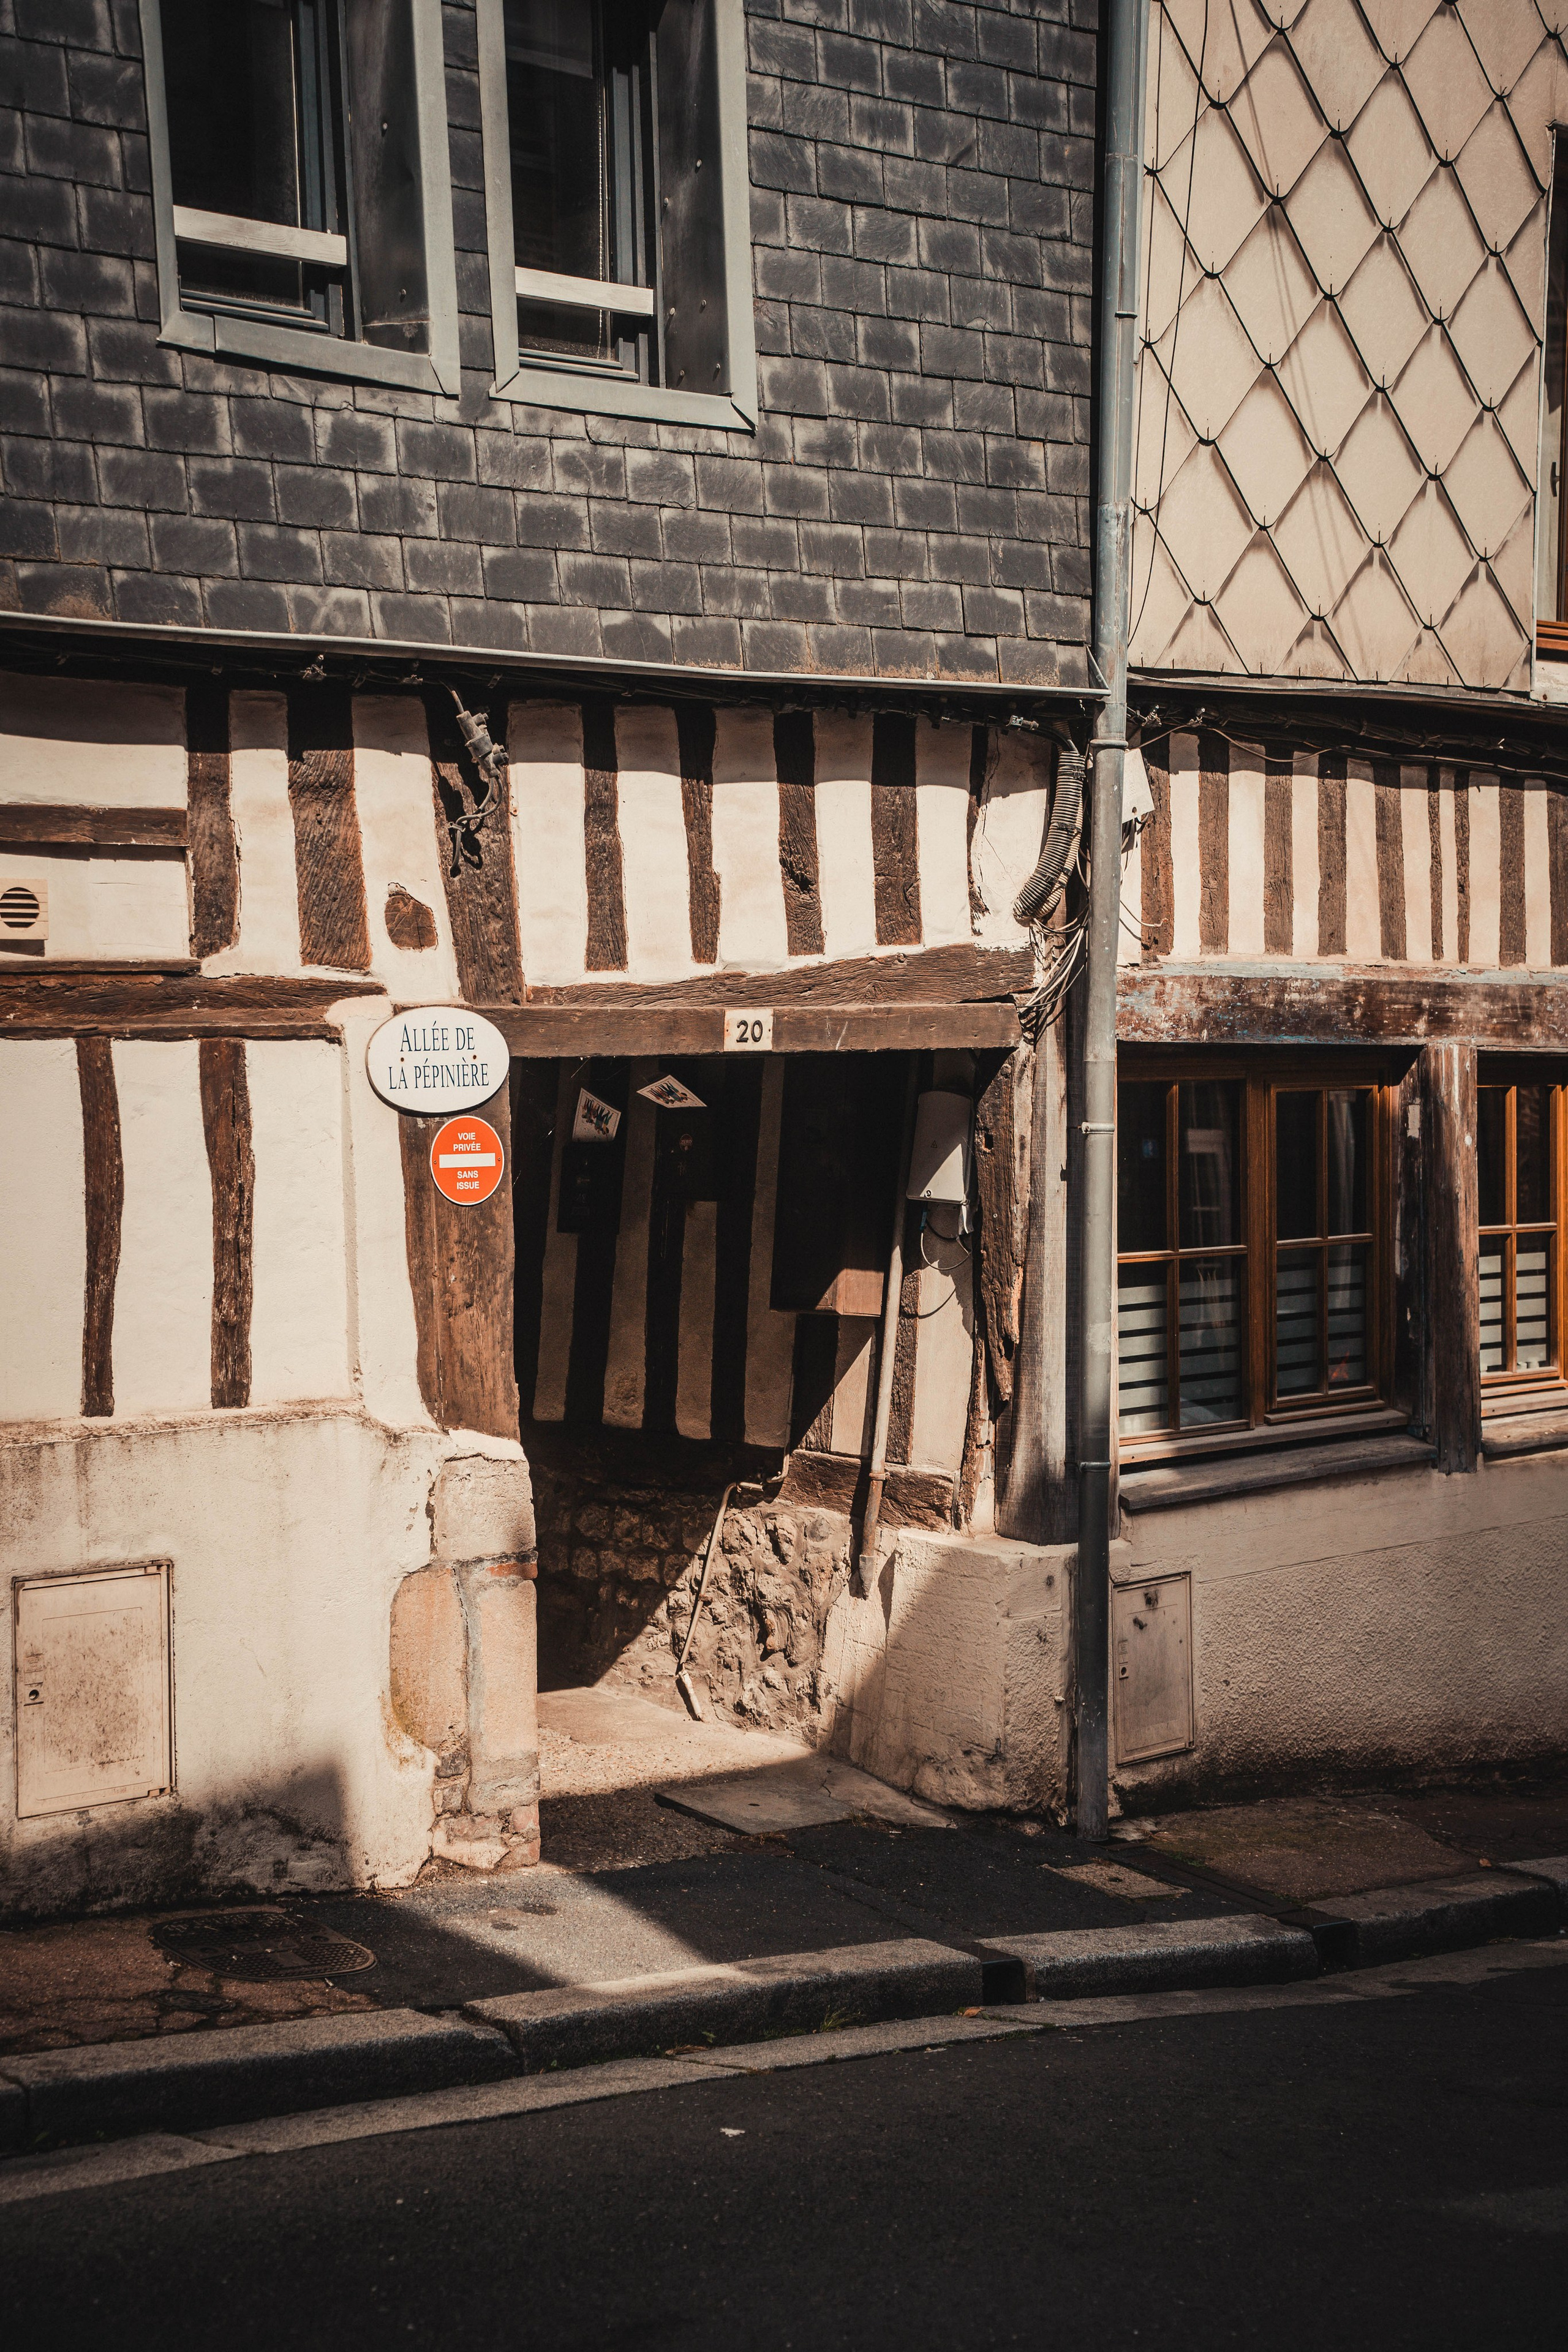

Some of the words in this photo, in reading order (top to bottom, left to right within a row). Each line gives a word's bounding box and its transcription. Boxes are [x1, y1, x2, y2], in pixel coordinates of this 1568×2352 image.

[401, 1020, 449, 1052] ALLÉE
[456, 1028, 475, 1050] DE
[736, 1020, 763, 1042] 20
[388, 1066, 408, 1089] LA
[414, 1057, 489, 1088] PÉPINIÈRE
[454, 1142, 481, 1151] PRIVÉE
